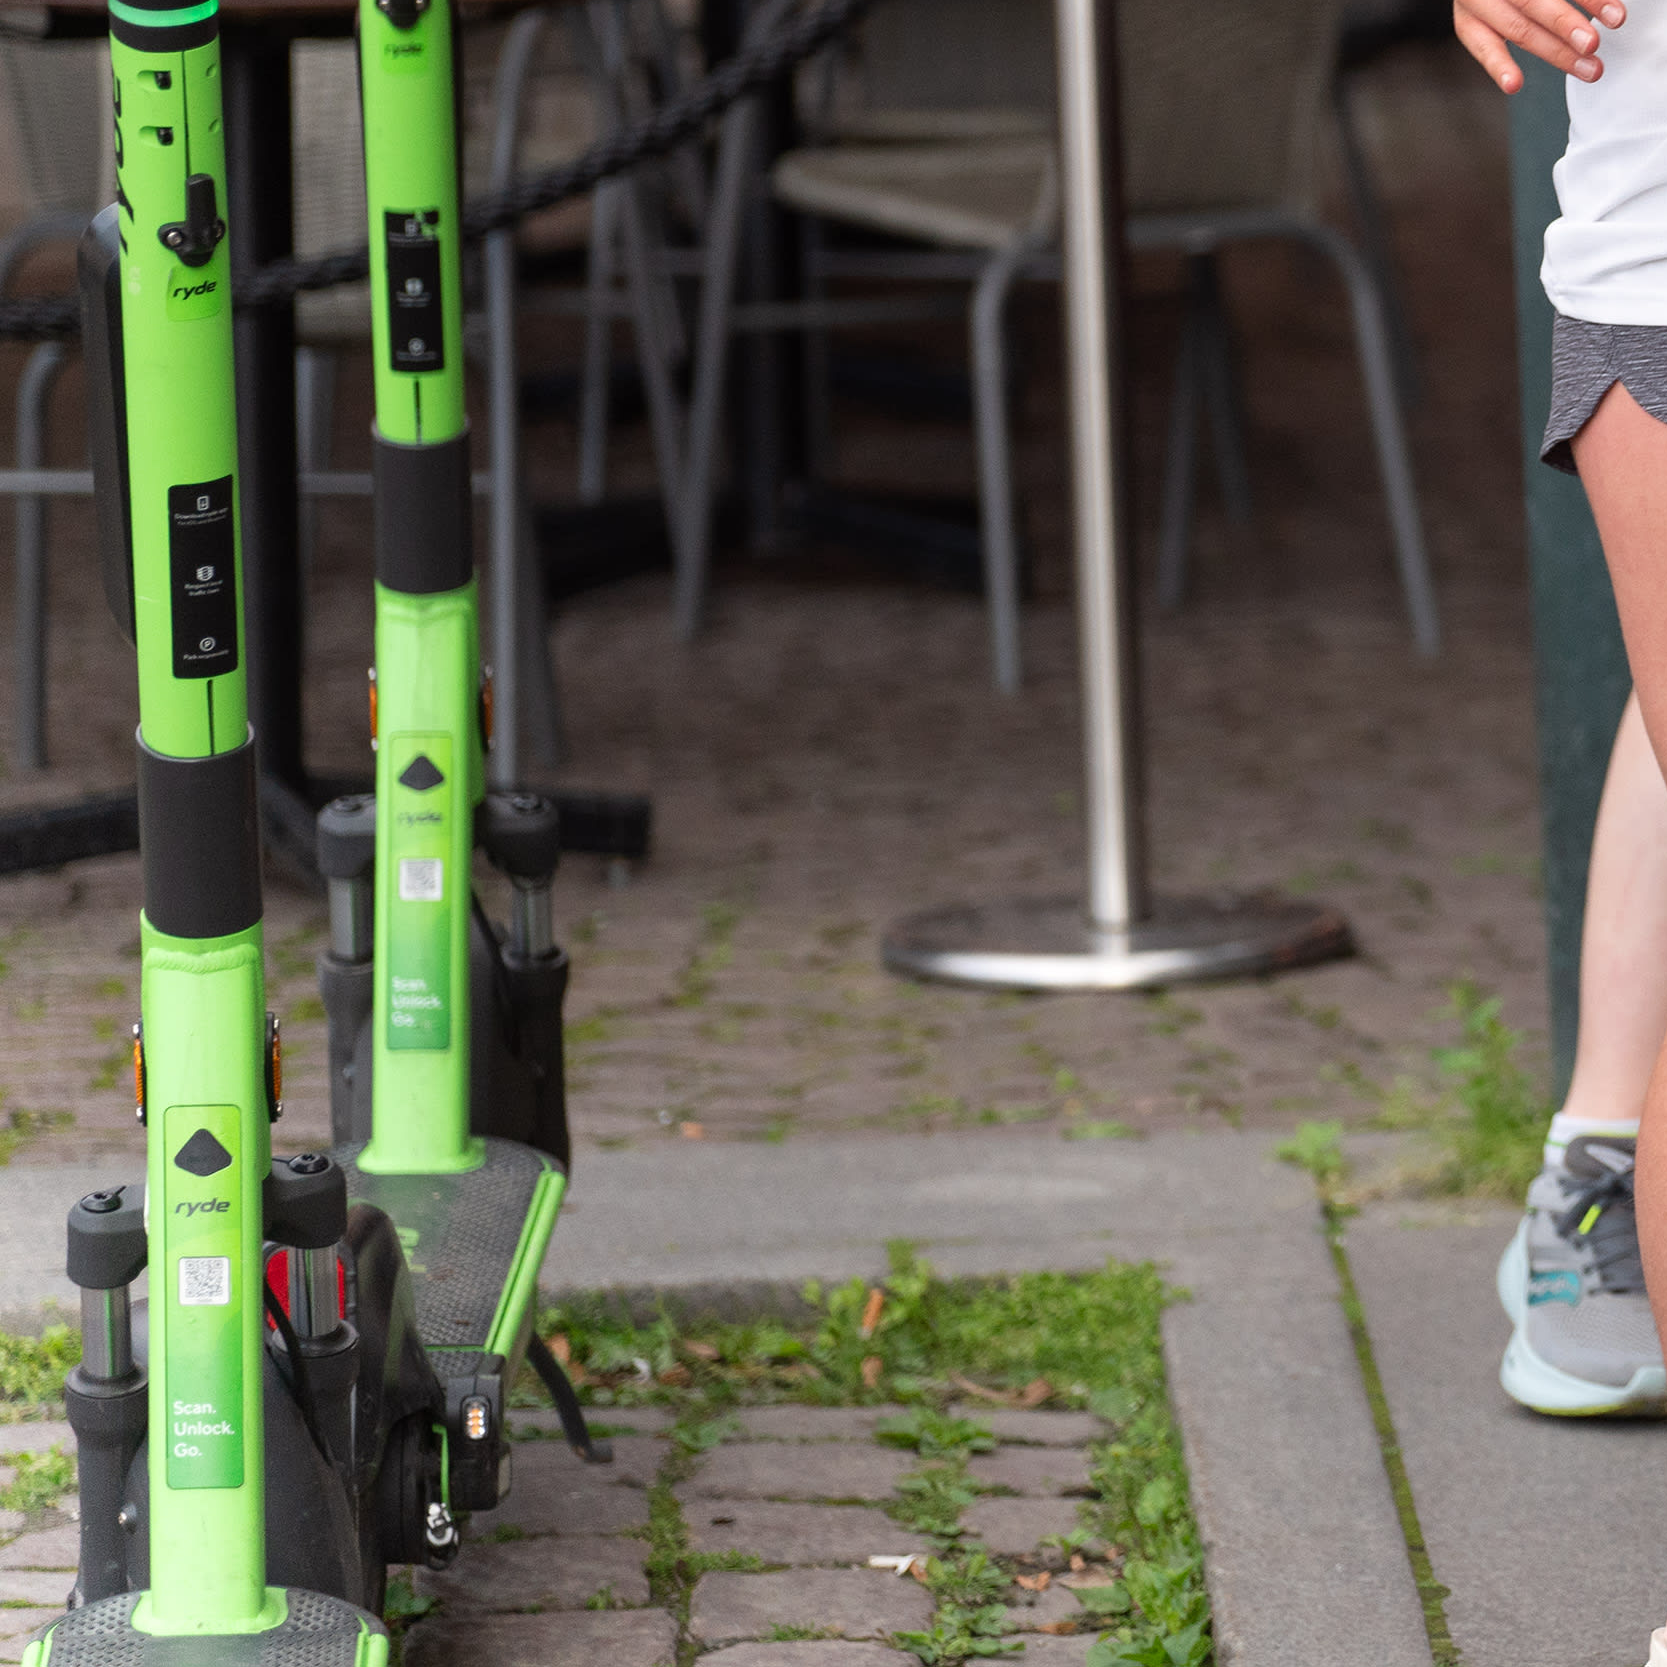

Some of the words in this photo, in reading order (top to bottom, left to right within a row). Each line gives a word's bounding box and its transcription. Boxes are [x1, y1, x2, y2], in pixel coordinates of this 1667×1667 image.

[172, 280, 217, 300] ryde
[175, 1197, 231, 1217] ryde
[173, 1400, 217, 1415] Scan.
[173, 1420, 236, 1436] Unlock.
[173, 1443, 203, 1458] Go.
